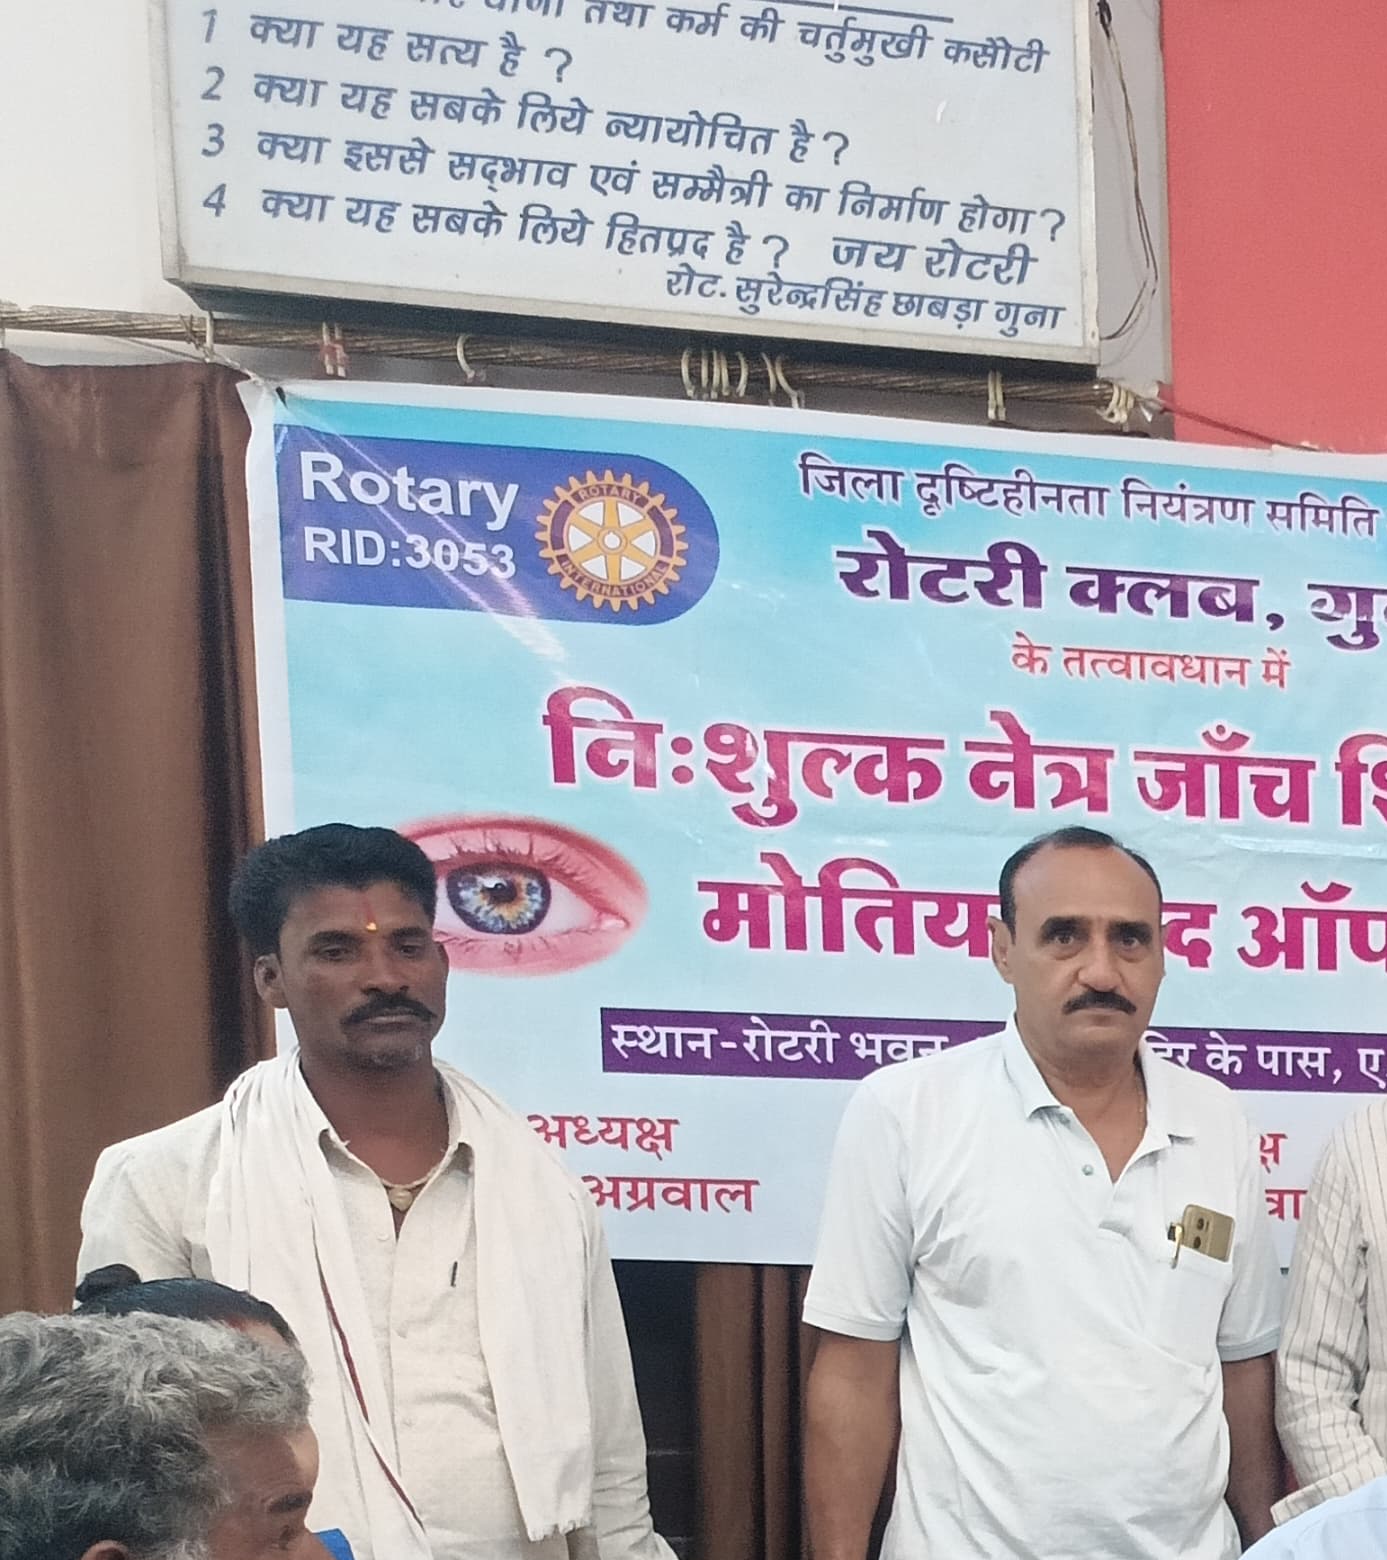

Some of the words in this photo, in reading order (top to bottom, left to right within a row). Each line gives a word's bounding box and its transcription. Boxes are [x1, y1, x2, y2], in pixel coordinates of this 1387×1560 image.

[202, 9, 217, 42] 1
[250, 15, 323, 48] क्या
[337, 24, 390, 60] यह
[406, 32, 487, 67] सत्य
[585, 0, 656, 28] तथा
[666, 3, 730, 36] कर्म
[740, 8, 784, 43] की
[798, 18, 933, 66] चर्तुमुखी
[944, 36, 1050, 74] कसौटी
[201, 66, 225, 100] 2
[254, 73, 328, 107] क्या
[341, 82, 397, 119] यह
[410, 87, 506, 125] सबके
[518, 92, 593, 135] लिये
[605, 111, 779, 155] न्यायोचित
[202, 124, 225, 157] 3
[258, 132, 331, 163] क्या
[344, 138, 434, 174] इससे
[590, 161, 640, 195] एवं
[653, 164, 772, 207] सम्मैत्री
[786, 184, 829, 214] का
[838, 181, 950, 225] निर्माण
[203, 183, 226, 216] 4
[262, 189, 334, 222] क्या
[346, 197, 400, 232] यह
[412, 201, 507, 237] सबके
[518, 203, 594, 245] लिये
[605, 212, 713, 259] हितप्रद
[833, 237, 916, 272] जय
[925, 239, 1038, 286] रोटरी
[666, 263, 726, 297] रोट.
[736, 272, 888, 315] सुरेन्द्रसिंह
[893, 291, 988, 334] छाबड़ा
[995, 304, 1066, 337] गुना
[300, 450, 519, 530] Rotary
[578, 485, 641, 504] ROTARY
[799, 452, 905, 500] जिला
[915, 463, 1109, 517] दृष्टिहीनता
[1120, 478, 1255, 527] नियंत्रण
[1266, 491, 1378, 538] समिति
[303, 525, 517, 581] RID:3053
[561, 560, 668, 597] INTERNATIONAL
[836, 530, 1047, 608] रोटरी
[1066, 565, 1285, 631] क्लब,
[1011, 632, 1051, 676] के
[1063, 644, 1251, 690] तत्वावधान
[1262, 648, 1291, 690] में
[965, 711, 1113, 813] नेत्र
[1133, 723, 1315, 822] जाँच
[1205, 1031, 1248, 1075] के
[1256, 1044, 1342, 1082] पास,
[581, 1175, 760, 1213] अग्रवाल
